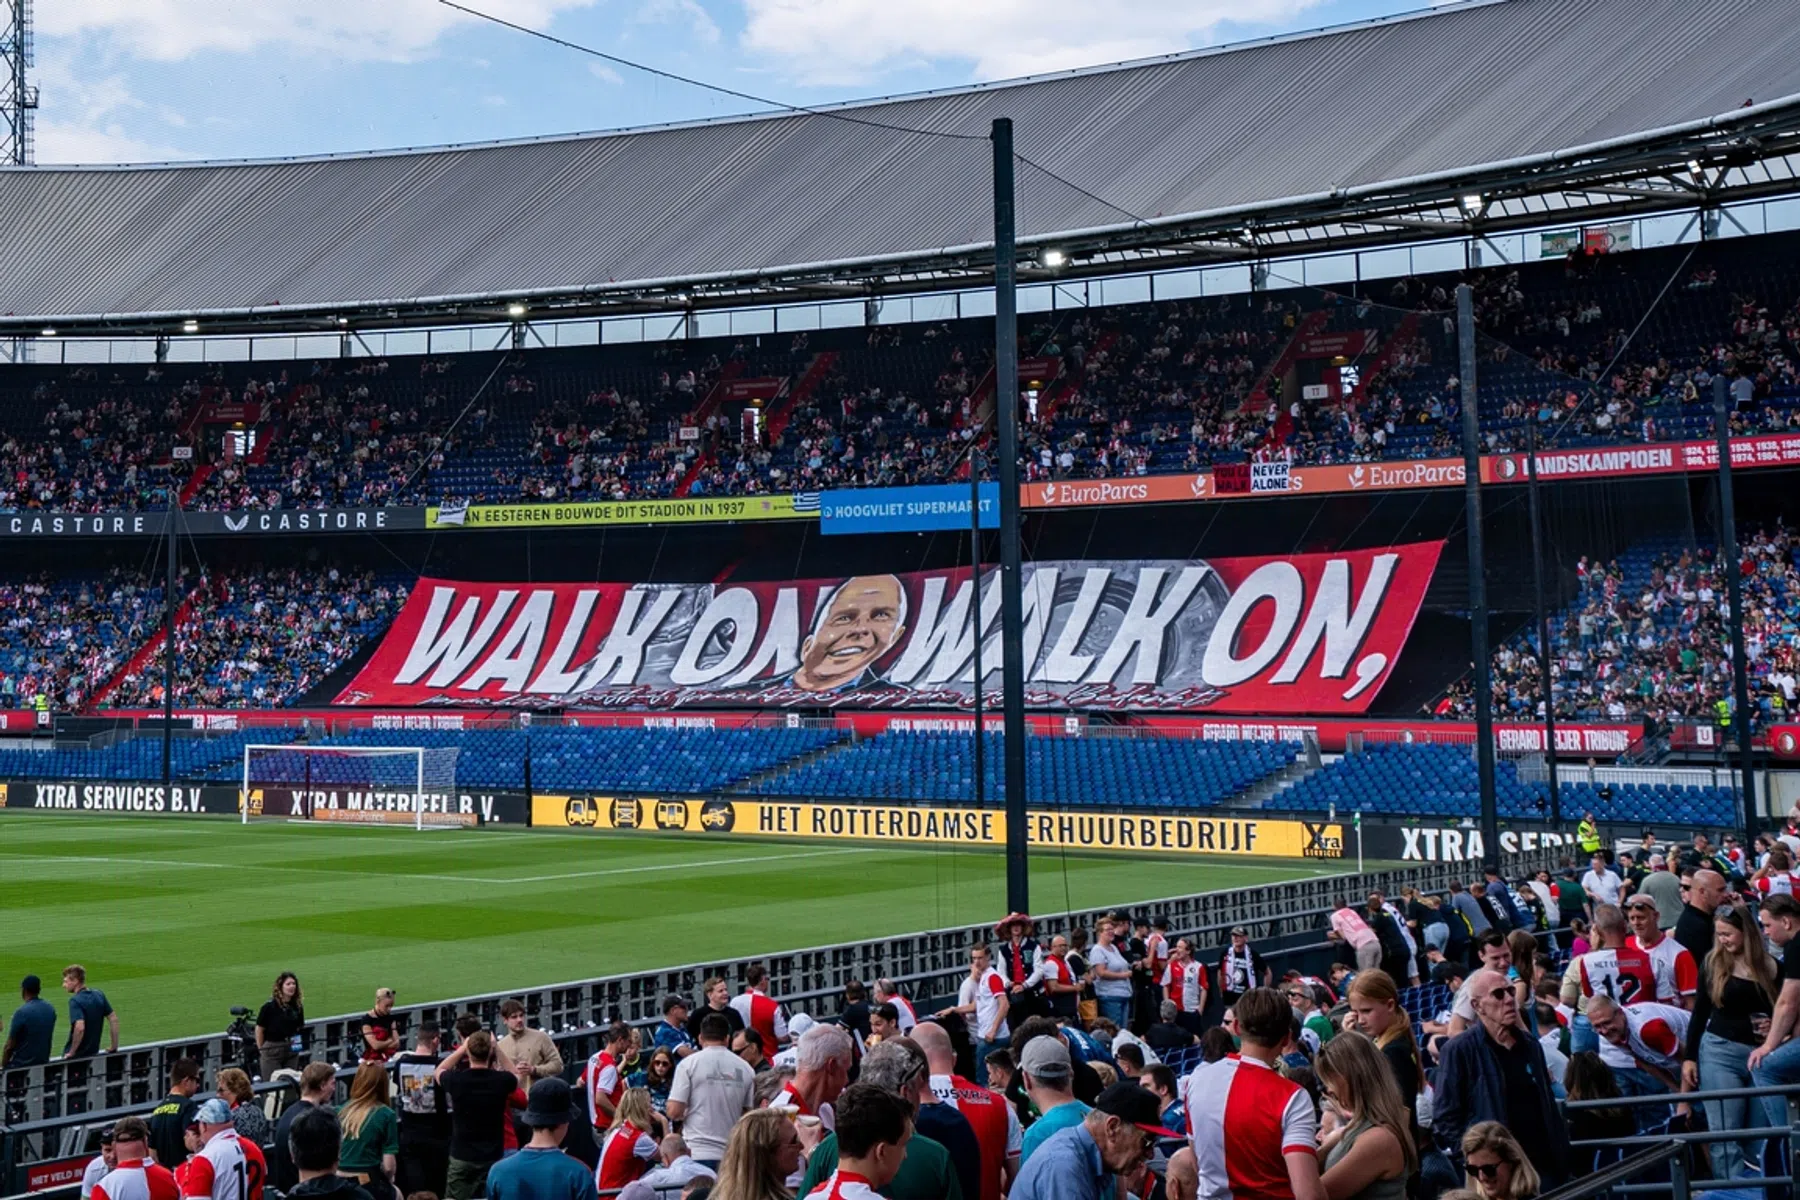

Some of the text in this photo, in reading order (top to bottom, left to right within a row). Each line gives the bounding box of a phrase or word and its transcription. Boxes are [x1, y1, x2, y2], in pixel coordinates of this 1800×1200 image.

[1253, 464, 1289, 477] NEVER
[1522, 448, 1672, 476] LANDSKAMPIOEN
[1252, 478, 1288, 490] ALONE
[1370, 463, 1466, 486] EuroParcs
[1060, 483, 1148, 503] EuroParcs
[260, 511, 386, 530] CASTORE
[485, 509, 551, 522] EESTEREN
[555, 507, 612, 520] BOUWDE
[616, 505, 637, 518] DIT
[640, 503, 695, 517] STADION
[700, 503, 714, 515] IN
[718, 502, 746, 515] 1937
[835, 503, 904, 518] HOOGVLIET
[11, 517, 144, 533] CASTORE
[393, 552, 1399, 701] WALK ON WALK ON,
[1500, 729, 1540, 750] GERARD
[1700, 730, 1710, 741] U
[35, 784, 78, 808] XTRA
[83, 785, 165, 811] SERVICES
[171, 787, 206, 812] B.V.
[759, 805, 1257, 851] HET ROTTERDAMSE ERHUURBEDRIJF
[1401, 827, 1486, 862] XTRA
[1602, 972, 1641, 1006] 12
[31, 1173, 50, 1186] HET
[51, 1170, 73, 1182] VELD
[233, 1160, 263, 1200] 12
